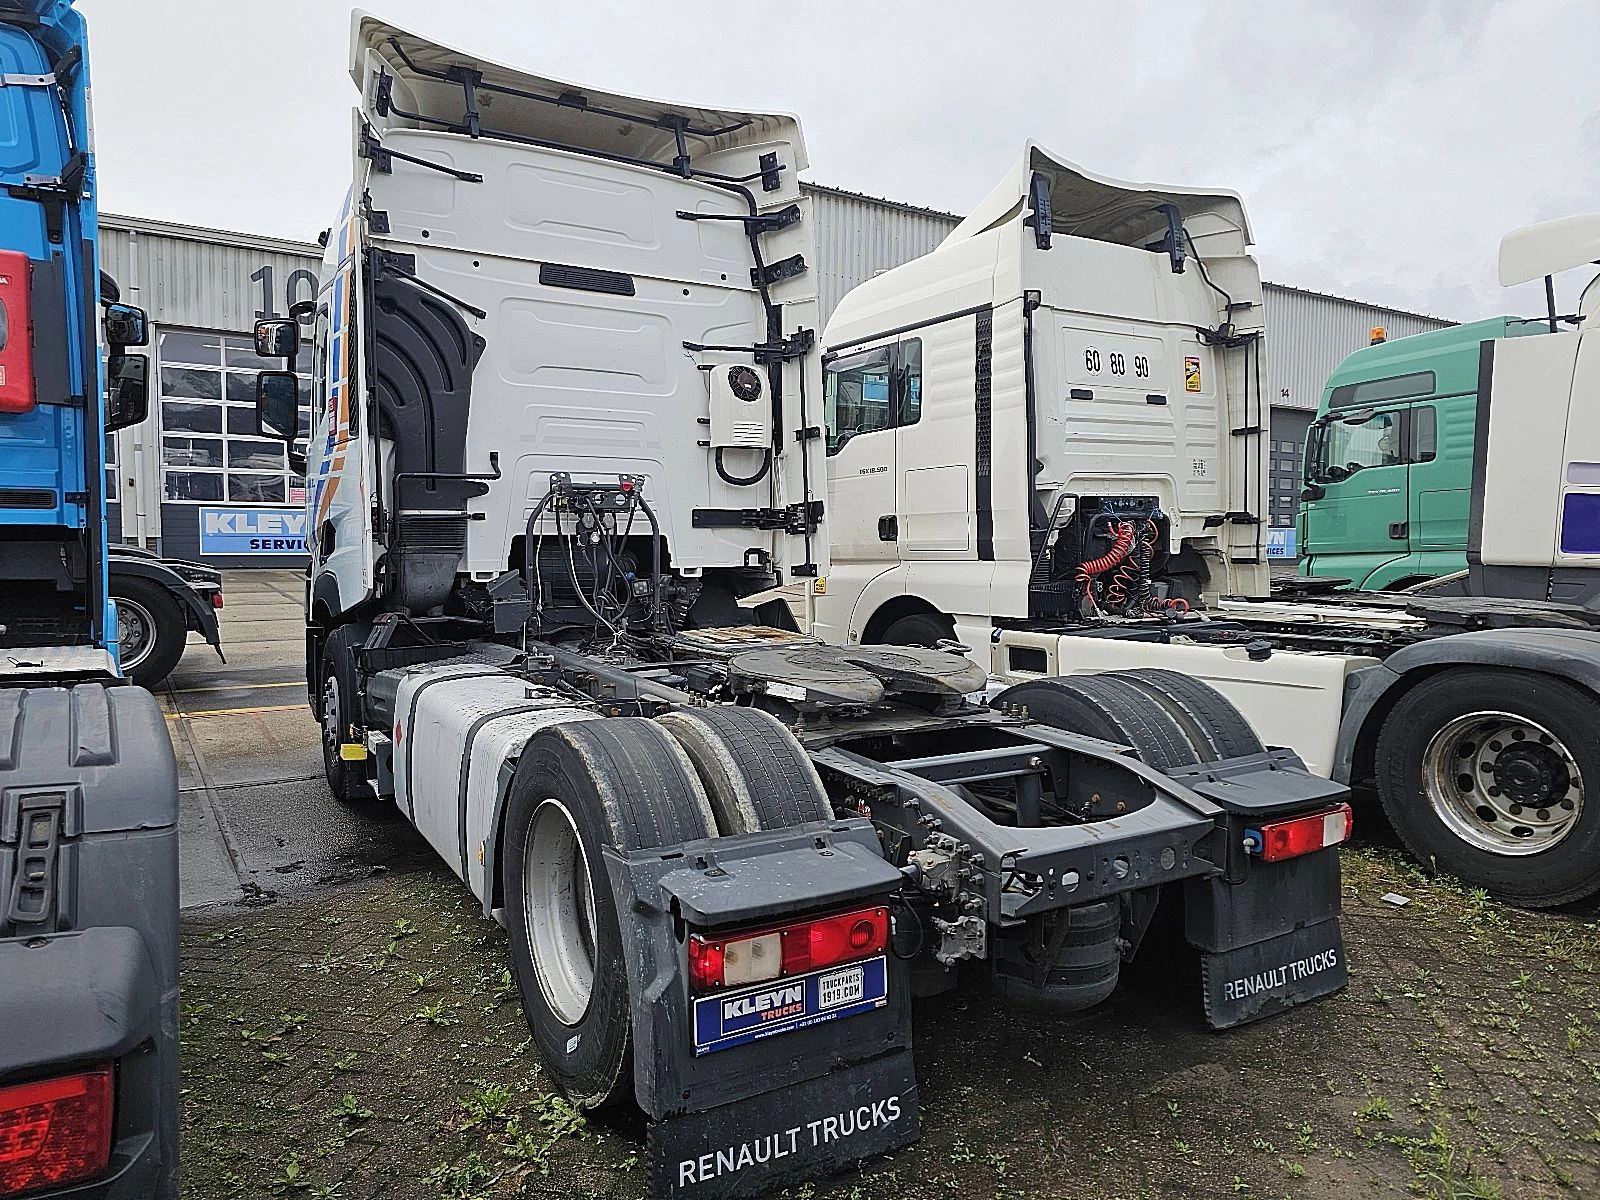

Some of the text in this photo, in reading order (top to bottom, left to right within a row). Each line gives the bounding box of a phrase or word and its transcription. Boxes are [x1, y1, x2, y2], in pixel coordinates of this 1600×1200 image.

[1085, 349, 1149, 378] 60 80 90
[1280, 387, 1290, 399] 14
[205, 512, 307, 535] KLEY
[822, 973, 861, 991] TRUCKPARTS
[1223, 948, 1338, 1001] RENAULT TRUCKS
[724, 985, 802, 1020] KLEYN
[822, 983, 861, 1004] 1919.COM
[760, 1003, 803, 1021] TRUCKS
[679, 1096, 901, 1188] RENAULT TRUCKS
